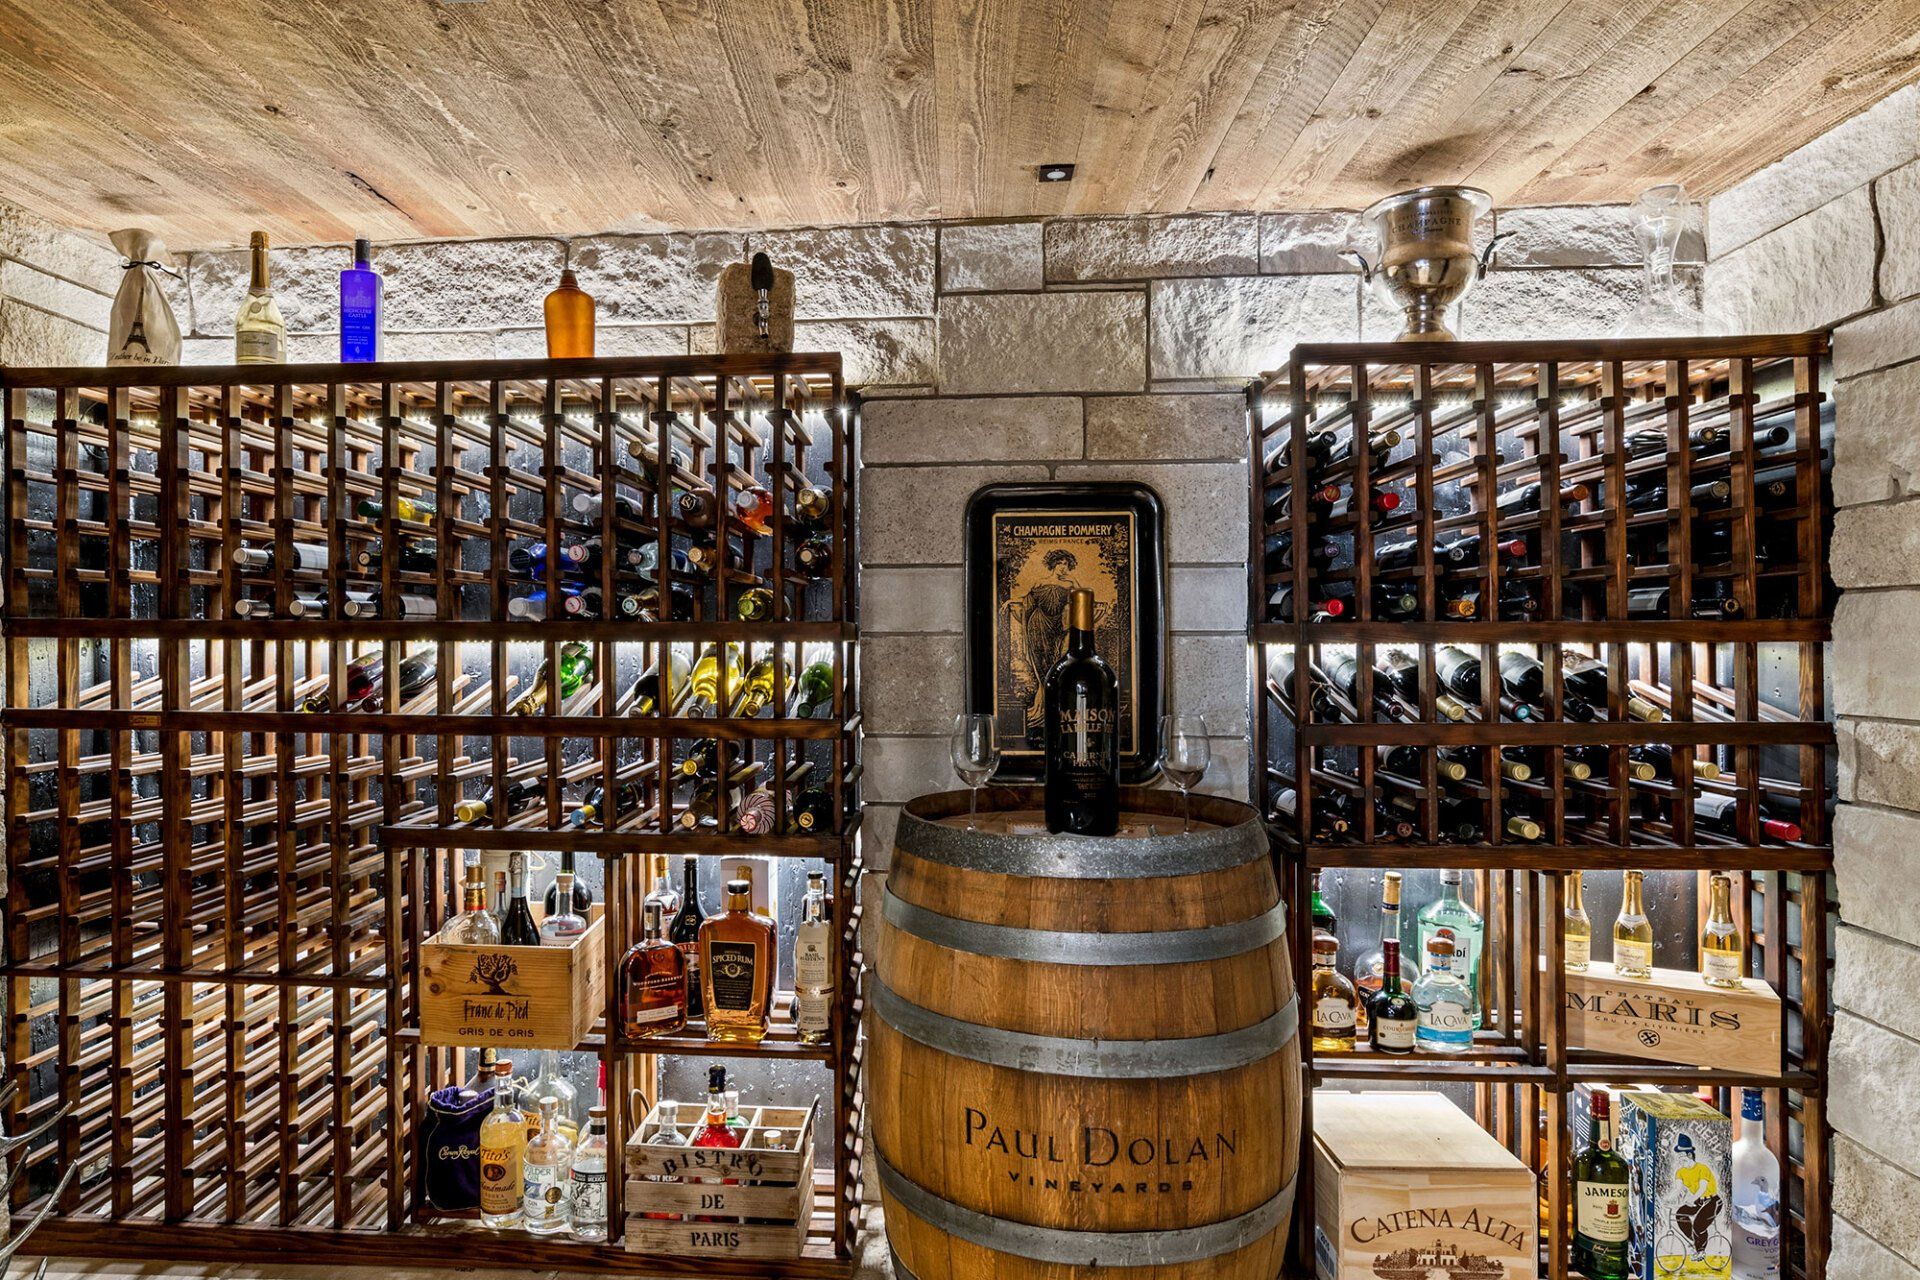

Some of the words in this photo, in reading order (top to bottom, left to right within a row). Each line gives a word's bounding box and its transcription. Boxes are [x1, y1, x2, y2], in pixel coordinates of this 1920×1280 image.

[1392, 216, 1461, 233] CHAMPAGNE
[1013, 525, 1067, 536] CHAMPAGNE
[1068, 524, 1113, 536] POMMERY
[1060, 708, 1114, 722] MAISON
[712, 954, 737, 963] SPICED
[737, 955, 753, 965] RUM
[464, 1000, 492, 1021] Franc
[495, 1002, 505, 1018] de
[506, 1000, 529, 1021] Pied
[1316, 1010, 1328, 1022] LA
[1566, 991, 1741, 1031] MARIS
[1430, 1013, 1442, 1026] LA
[1595, 1015, 1617, 1023] CRU
[458, 1027, 485, 1036] GRIS
[489, 1028, 504, 1037] DE
[508, 1029, 535, 1038] GRIS
[965, 1107, 1063, 1163] PAUL
[1084, 1127, 1236, 1166] DOLAN
[438, 1145, 459, 1160] Crown
[459, 1144, 480, 1159] Royal
[480, 1148, 511, 1160] Tito's
[662, 1150, 763, 1176] BISTRO
[1008, 1171, 1193, 1193] VINEYARDS
[1585, 1186, 1629, 1198] JAMESO
[701, 1194, 725, 1209] DE
[1350, 1208, 1454, 1244] CATENA
[1460, 1207, 1525, 1251] ALTA
[691, 1232, 740, 1247] PARIS
[1746, 1236, 1772, 1247] GREY
